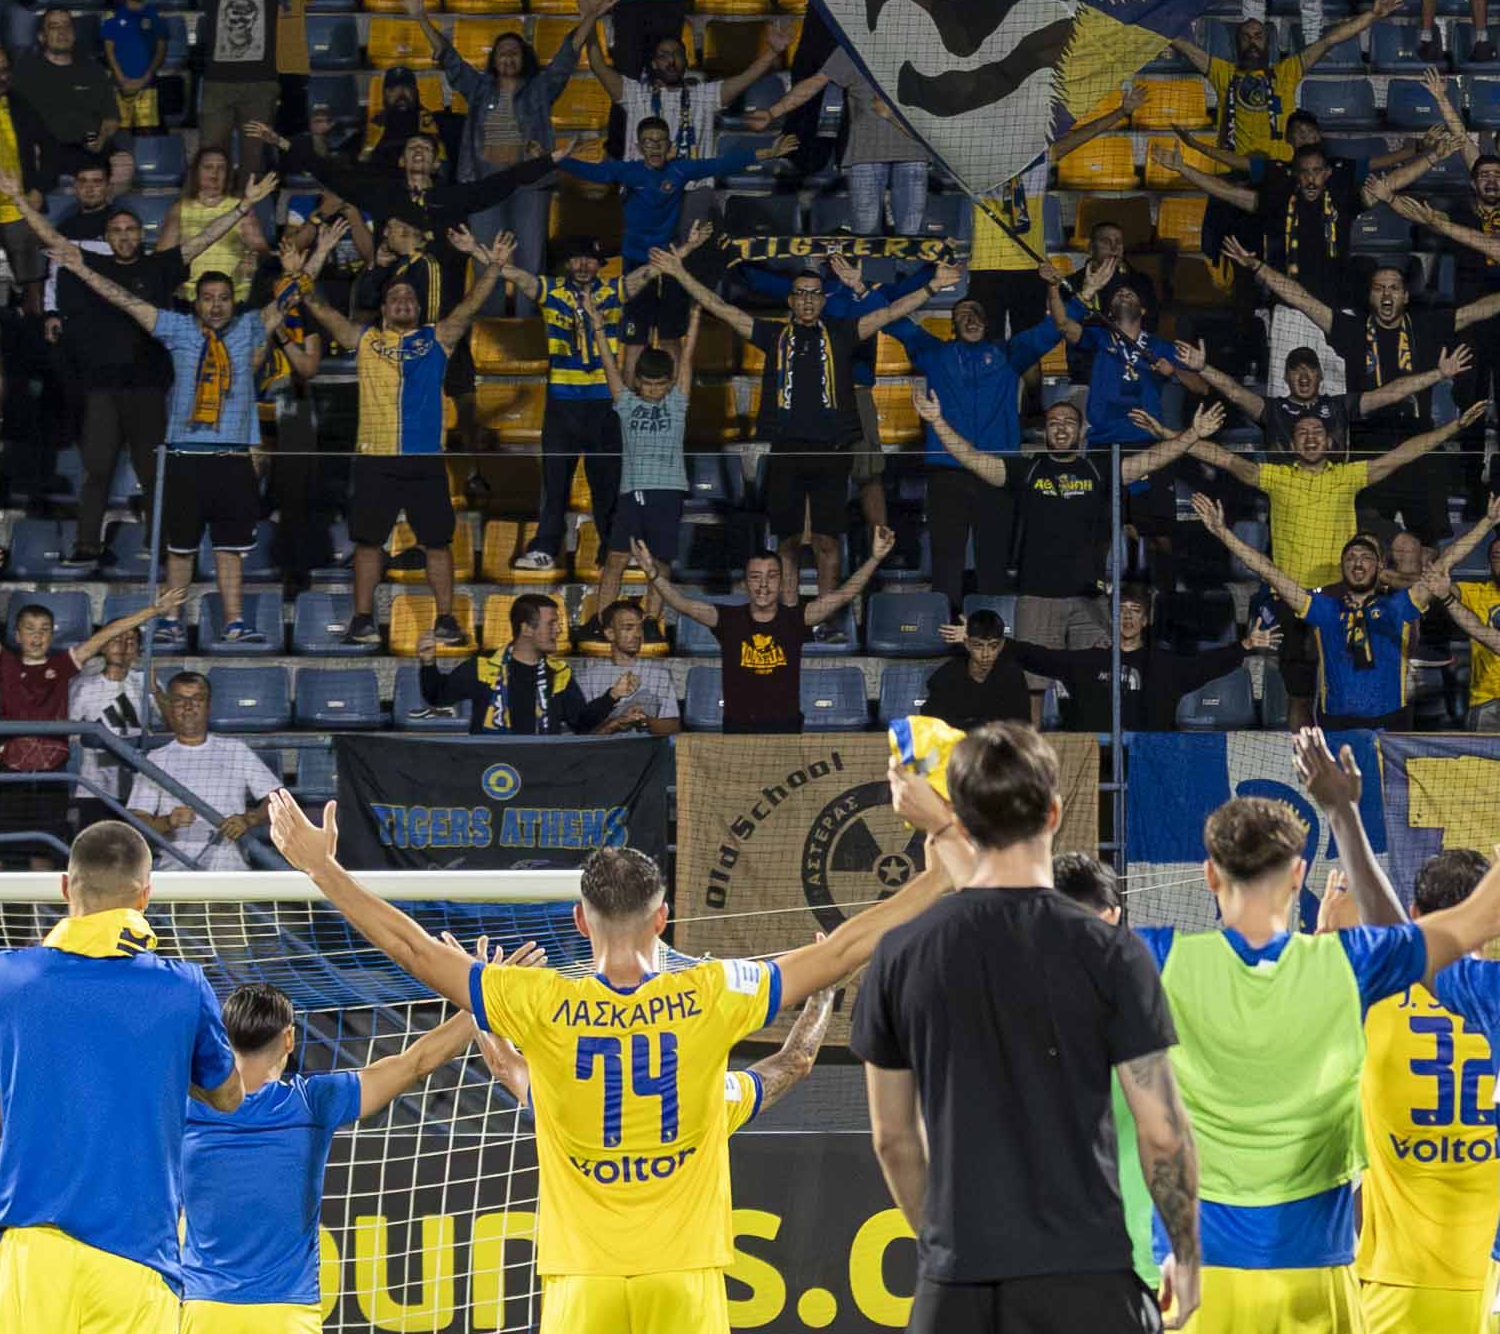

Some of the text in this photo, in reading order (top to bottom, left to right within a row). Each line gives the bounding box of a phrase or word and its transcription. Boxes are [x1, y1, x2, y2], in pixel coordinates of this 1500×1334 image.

[732, 234, 946, 262] TIGERS
[369, 802, 629, 850] TIGERS ATHENS
[551, 990, 703, 1028] ΛΑΣΚΑΡΗΣ
[575, 1032, 679, 1147] 74
